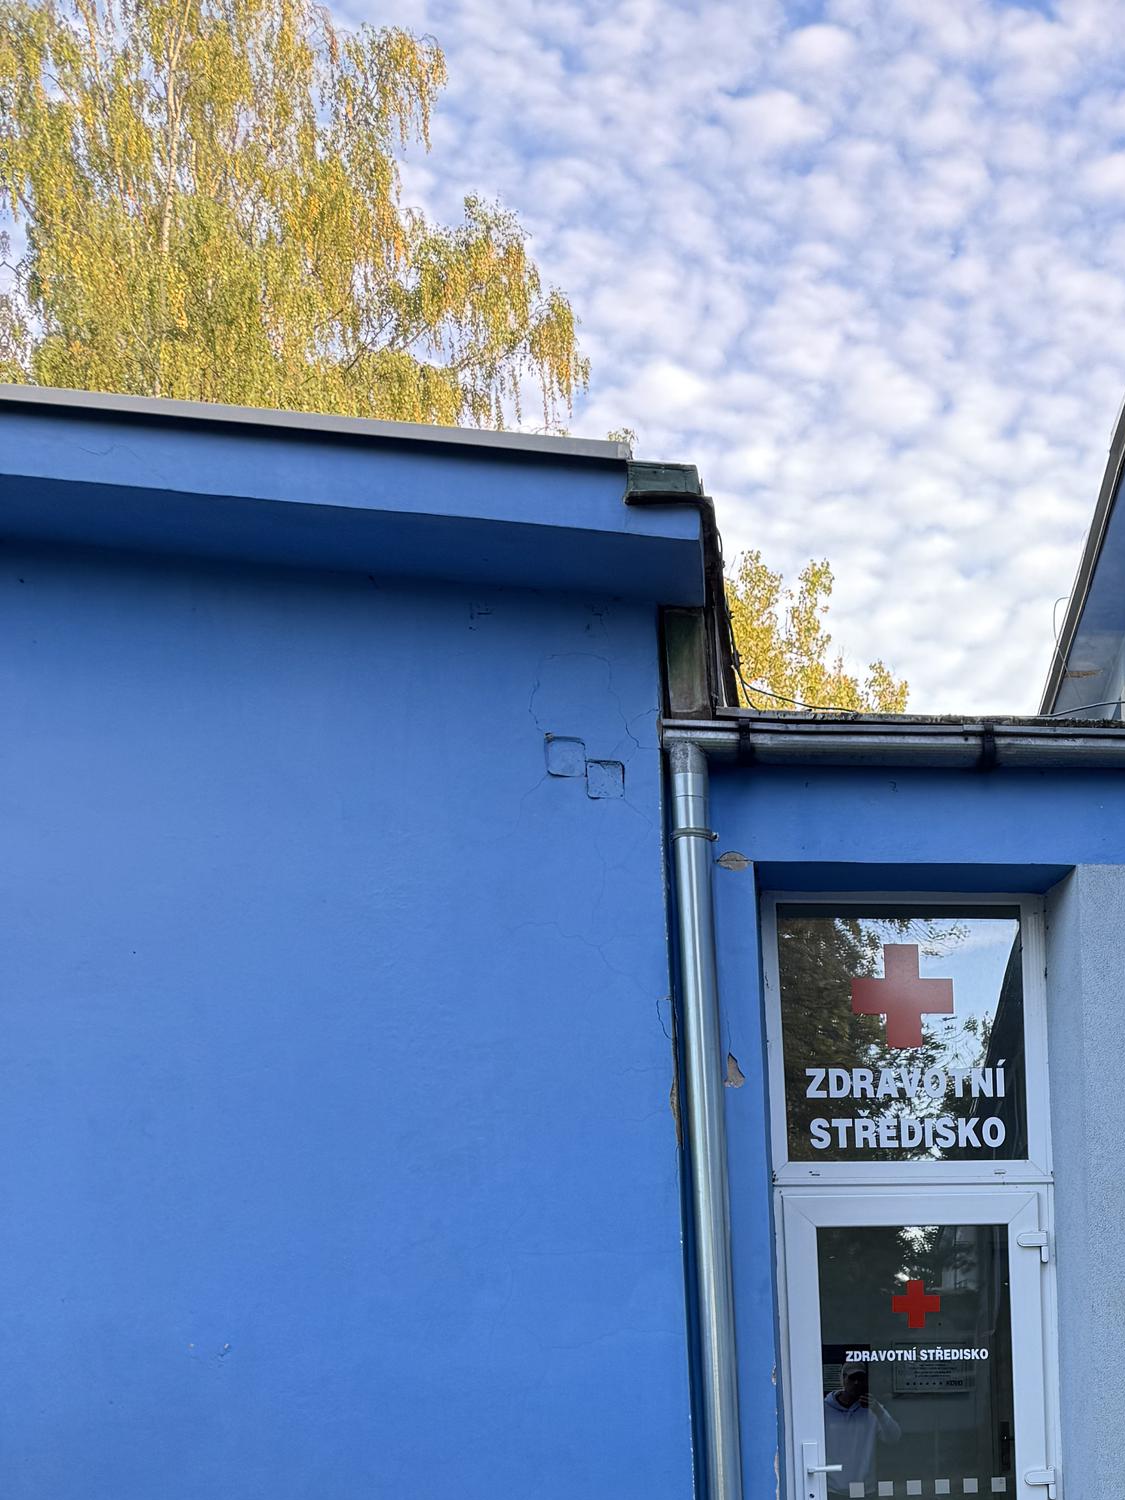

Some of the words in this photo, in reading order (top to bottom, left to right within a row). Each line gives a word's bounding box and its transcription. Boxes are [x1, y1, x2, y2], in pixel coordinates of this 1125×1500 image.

[805, 1059, 1006, 1098] ZDRAVOTNÍ
[809, 1109, 1006, 1149] STŘEDISKO
[845, 1347, 917, 1362] ZDRAVOTNÍ
[920, 1346, 989, 1361] STŘEDISKO
